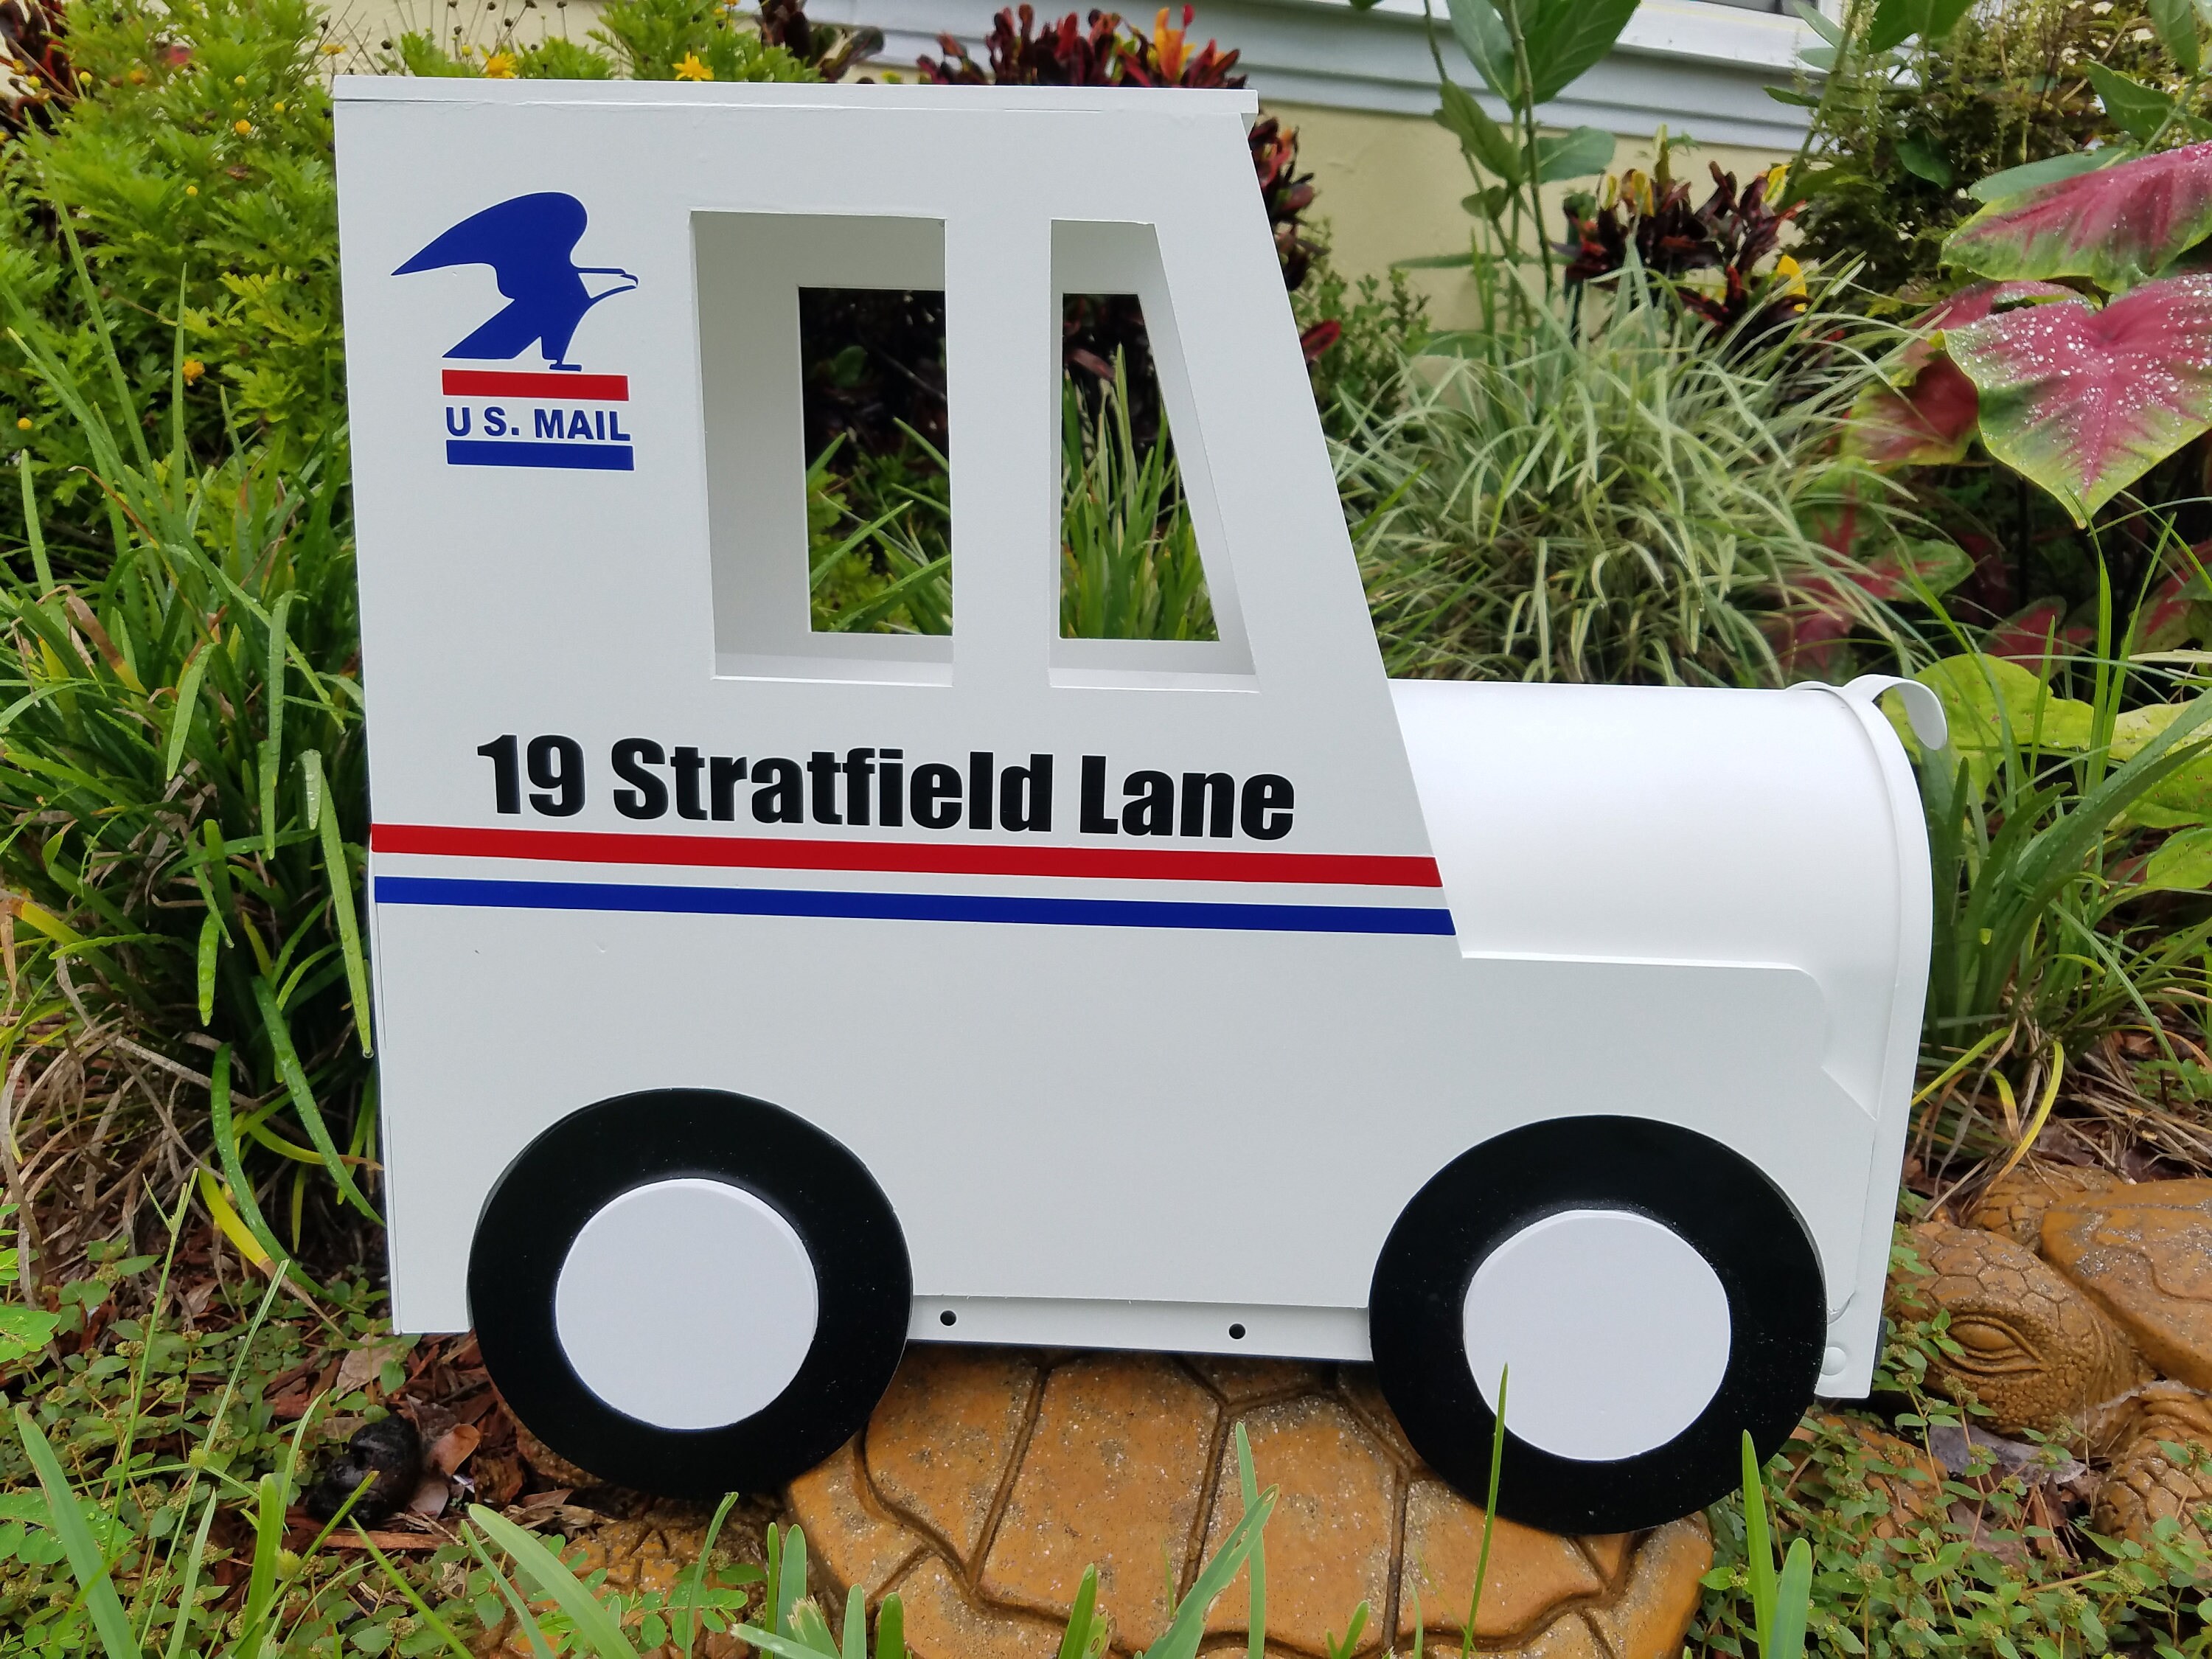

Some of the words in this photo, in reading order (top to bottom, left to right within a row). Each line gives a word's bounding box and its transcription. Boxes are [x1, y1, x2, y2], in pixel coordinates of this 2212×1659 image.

[534, 408, 631, 442] MAIL
[476, 734, 585, 817] 19
[611, 737, 1054, 833] Stratfield
[1079, 755, 1295, 841] Lane
